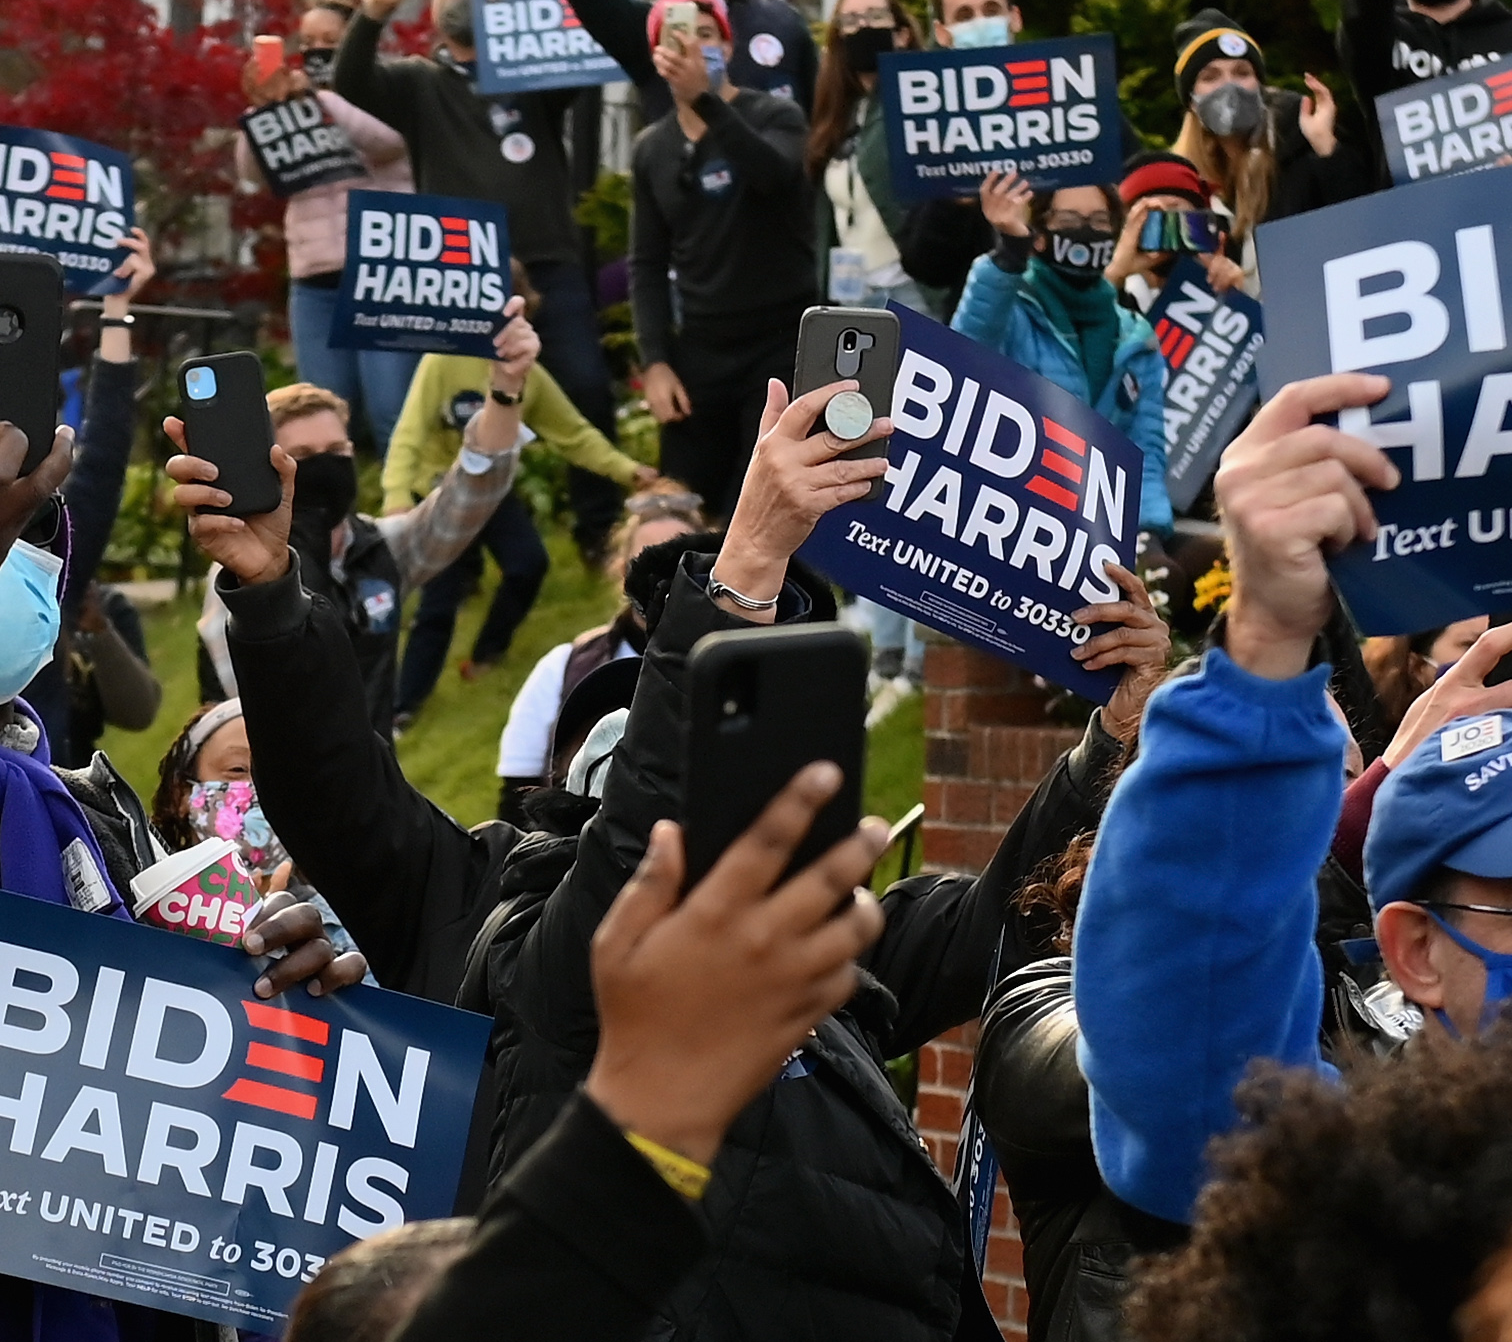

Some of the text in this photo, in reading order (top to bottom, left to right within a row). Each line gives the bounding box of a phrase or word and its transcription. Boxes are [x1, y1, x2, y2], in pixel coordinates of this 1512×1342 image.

[486, 27, 604, 63] HARR
[898, 54, 1096, 115] BIDEN
[246, 95, 333, 147] BID
[903, 103, 1101, 155] HARRIS
[948, 159, 1017, 177] UNITED
[359, 209, 500, 268] BIDEN
[353, 263, 506, 313] HARRIS
[379, 314, 435, 329] UNITED
[1163, 305, 1250, 451] ARRIS
[890, 348, 1127, 542] BIDEN
[884, 448, 1123, 605] HARRIS
[1373, 516, 1457, 563] Text
[844, 519, 892, 557] Text
[892, 540, 990, 600] UNITED
[989, 588, 1013, 612] to
[1012, 595, 1092, 646] 30330
[1450, 720, 1494, 747] JOE
[39, 1193, 202, 1257] UNITED
[208, 1231, 243, 1266] to
[251, 1239, 326, 1285] 303
